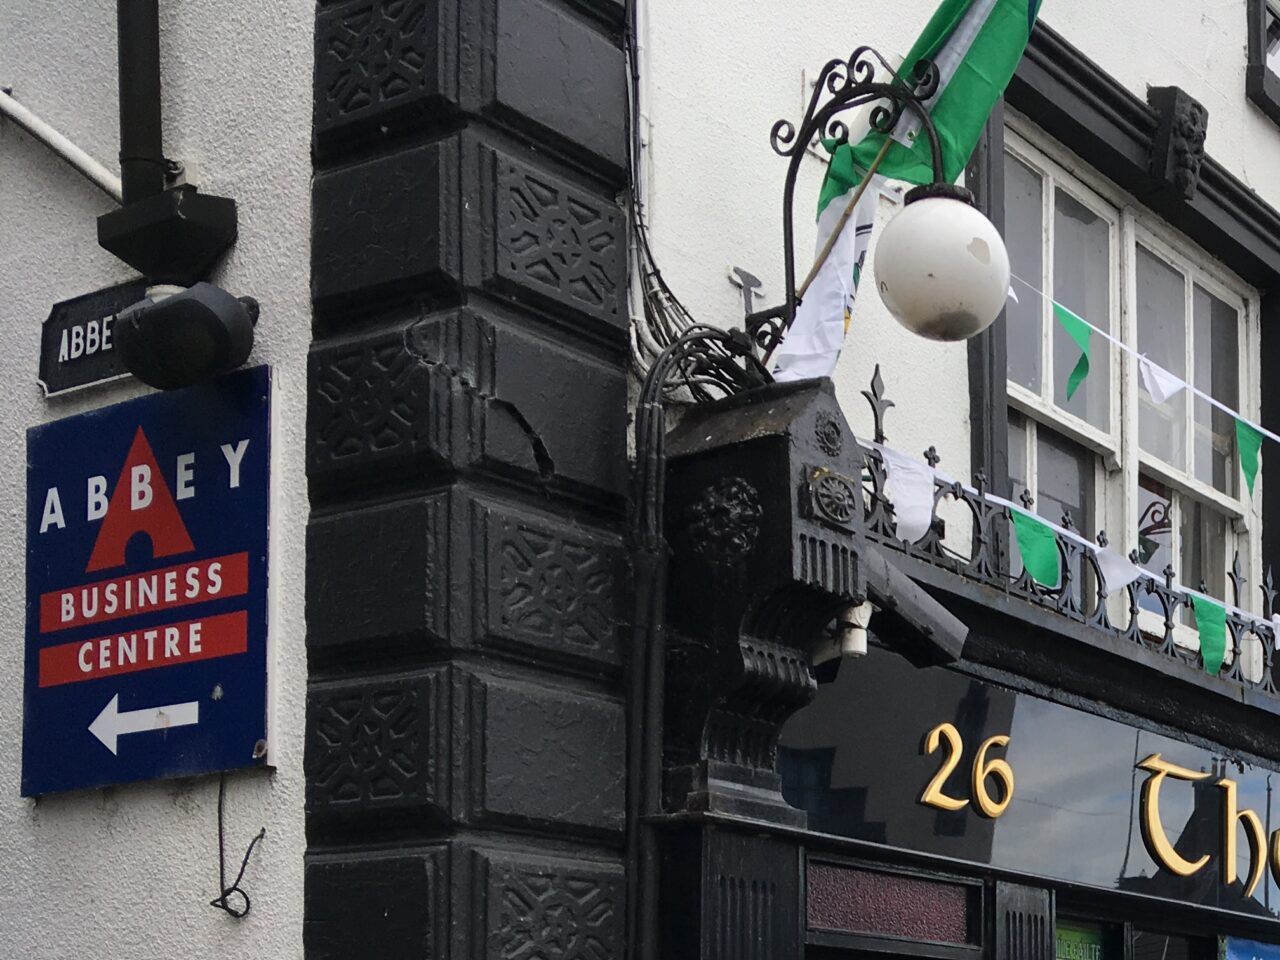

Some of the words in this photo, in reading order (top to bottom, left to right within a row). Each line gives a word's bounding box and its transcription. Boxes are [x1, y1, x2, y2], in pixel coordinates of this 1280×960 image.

[58, 314, 118, 362] ABBE
[39, 438, 250, 534] ABBEY
[60, 561, 223, 623] BUSINESS
[77, 622, 203, 673] CENTRE
[919, 721, 1015, 819] 26
